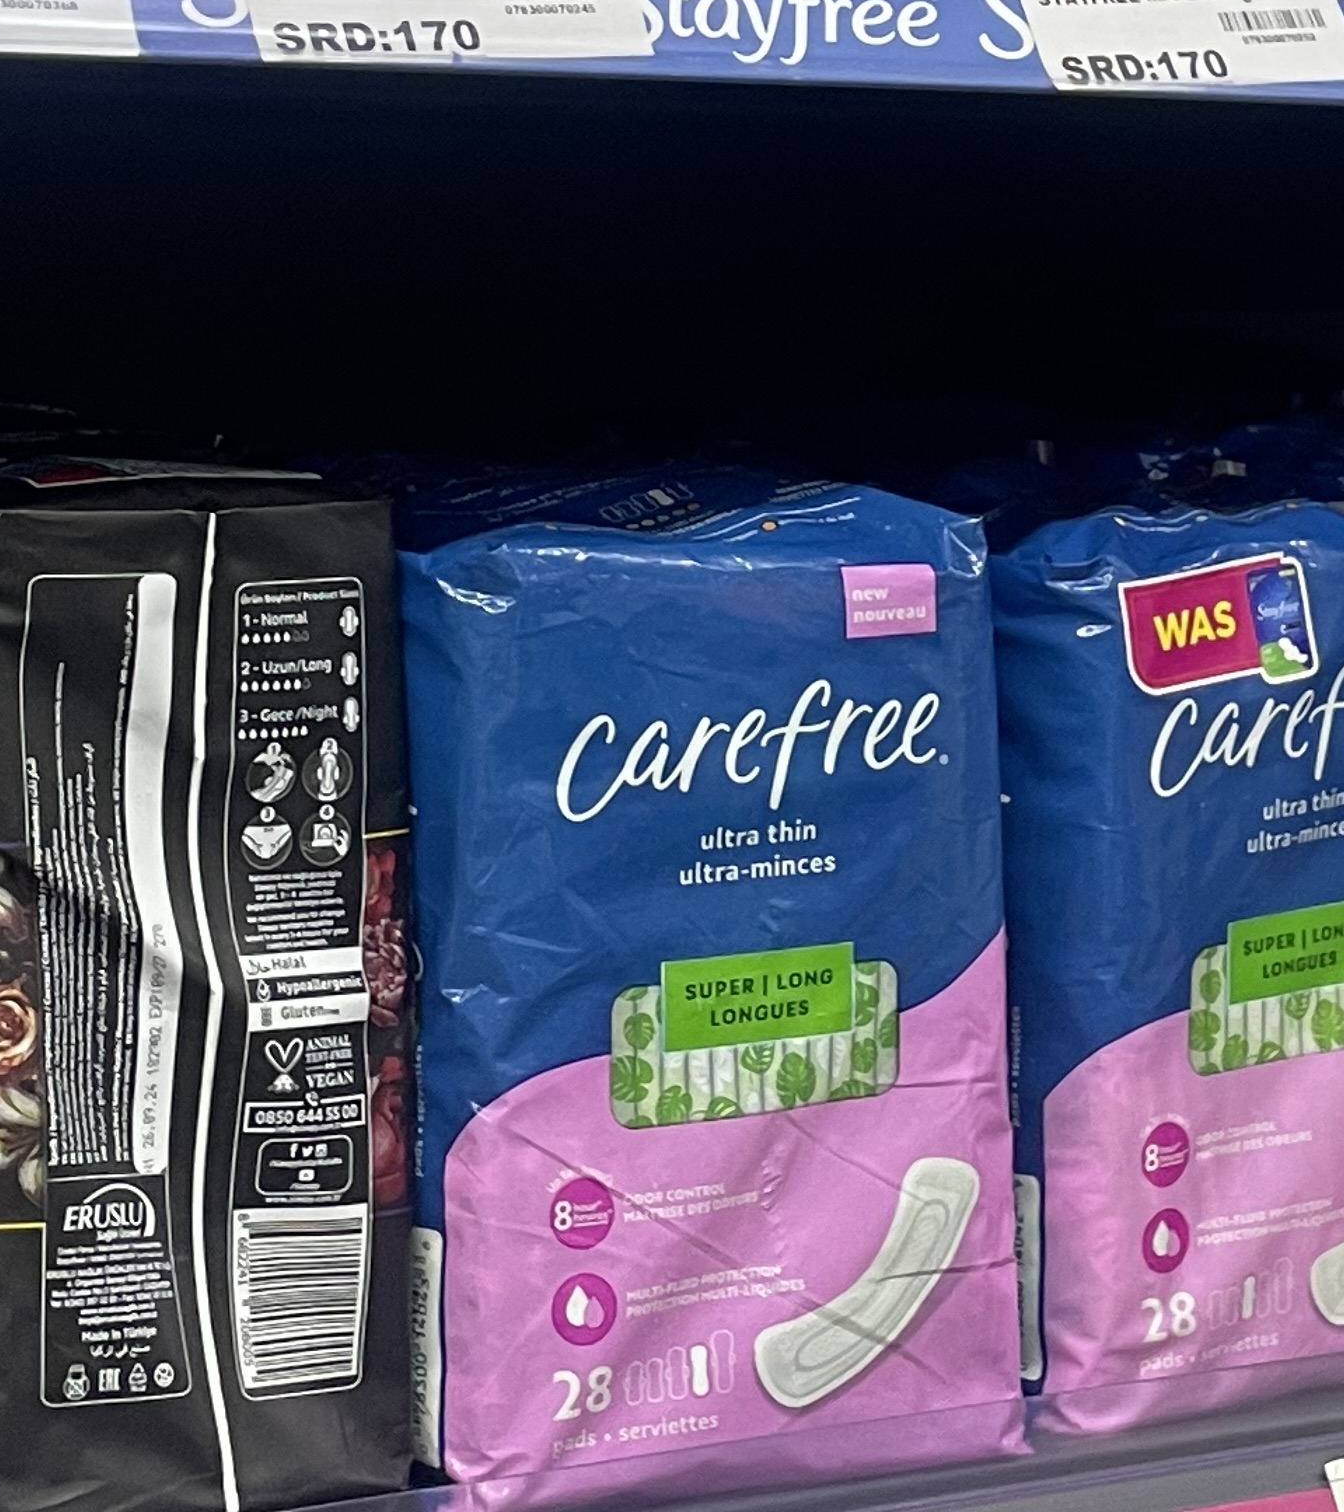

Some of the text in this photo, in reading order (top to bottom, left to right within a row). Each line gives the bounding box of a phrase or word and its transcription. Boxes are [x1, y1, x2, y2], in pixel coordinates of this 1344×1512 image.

[274, 20, 481, 54] SRD:170
[1061, 49, 1229, 86] SRD:170
[852, 587, 888, 602] new
[242, 611, 309, 627] 1 Normal
[853, 605, 927, 623] nouveau
[1153, 601, 1236, 651] WAS
[241, 662, 251, 675] 2
[239, 710, 249, 723] 3
[1262, 794, 1309, 821] ultra
[700, 819, 818, 851] ultra thin
[679, 851, 837, 887] ultra-minces
[1242, 930, 1296, 960] SUPER
[272, 956, 306, 970] Halal
[1262, 950, 1338, 982] LONGUES
[277, 976, 363, 994] Hypoallergenic
[685, 967, 835, 1002] SUPER LONG
[710, 998, 811, 1030] LONGUES
[306, 1070, 354, 1089] VEGAN
[255, 1109, 294, 1125] 0850
[297, 1107, 323, 1124] 644
[1145, 1144, 1159, 1172] 8
[63, 1202, 143, 1231] ERUSLU
[554, 1201, 573, 1231] 8
[1141, 1291, 1196, 1343] 28
[1139, 1353, 1185, 1378] pads
[552, 1366, 613, 1421] 28
[619, 1413, 719, 1442] serviettes
